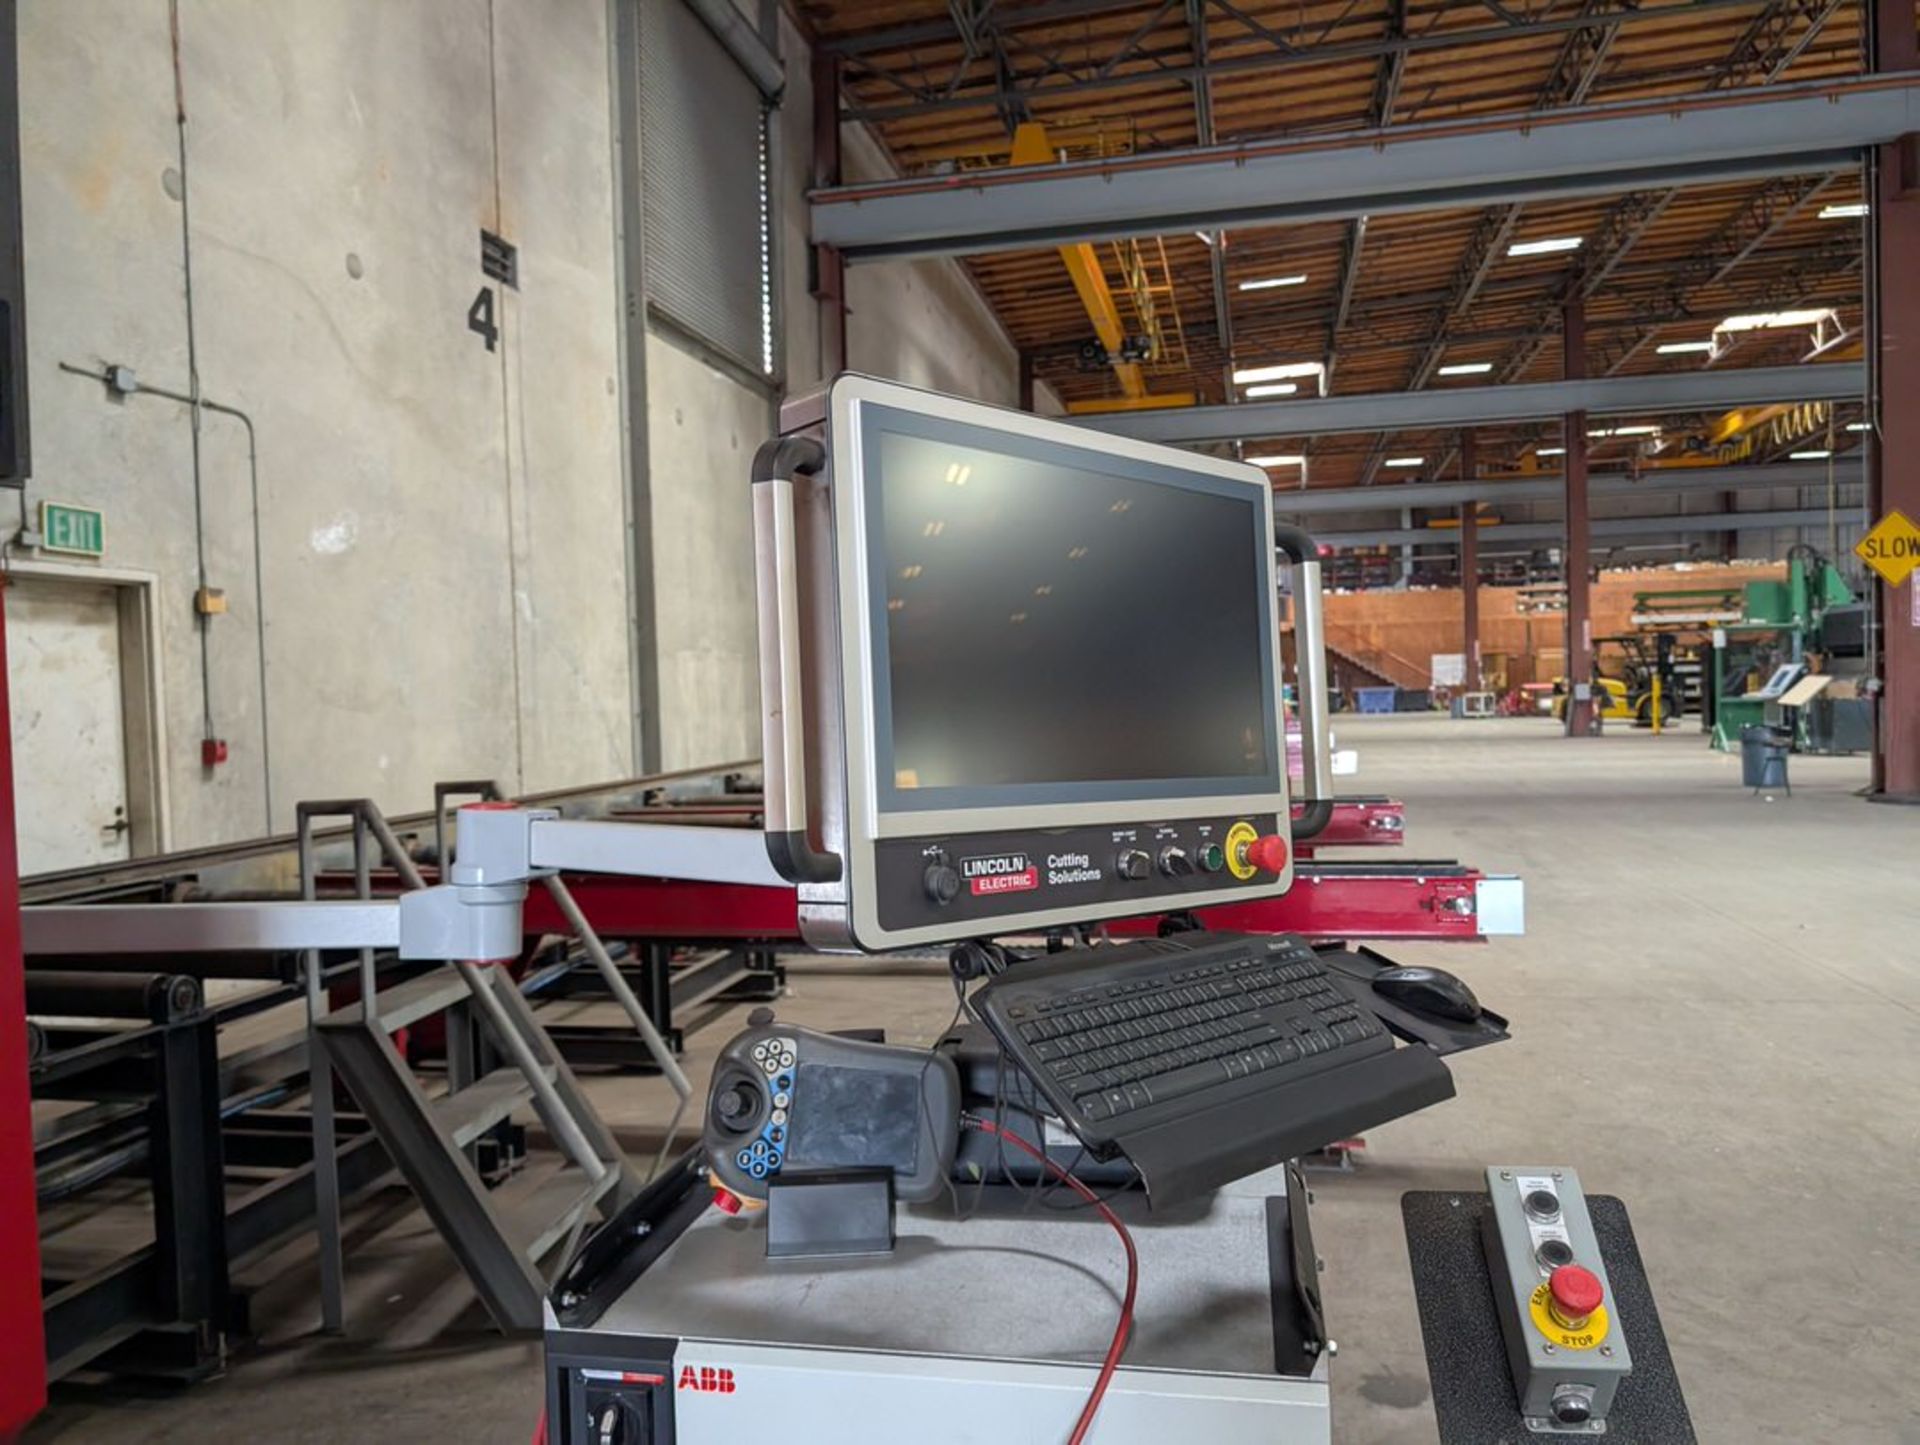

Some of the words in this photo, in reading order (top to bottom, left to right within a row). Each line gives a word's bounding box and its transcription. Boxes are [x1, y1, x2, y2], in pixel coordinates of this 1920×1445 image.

[468, 286, 498, 354] 4
[53, 508, 96, 550] EXIT
[1865, 537, 1920, 559] SLOW
[963, 857, 1024, 877] LINCOLN
[1047, 853, 1089, 868] Cutting
[979, 874, 1032, 890] ELECTRIC
[1048, 869, 1102, 885] Solutions
[1561, 1334, 1594, 1346] STOP
[678, 1365, 736, 1393] ABB
